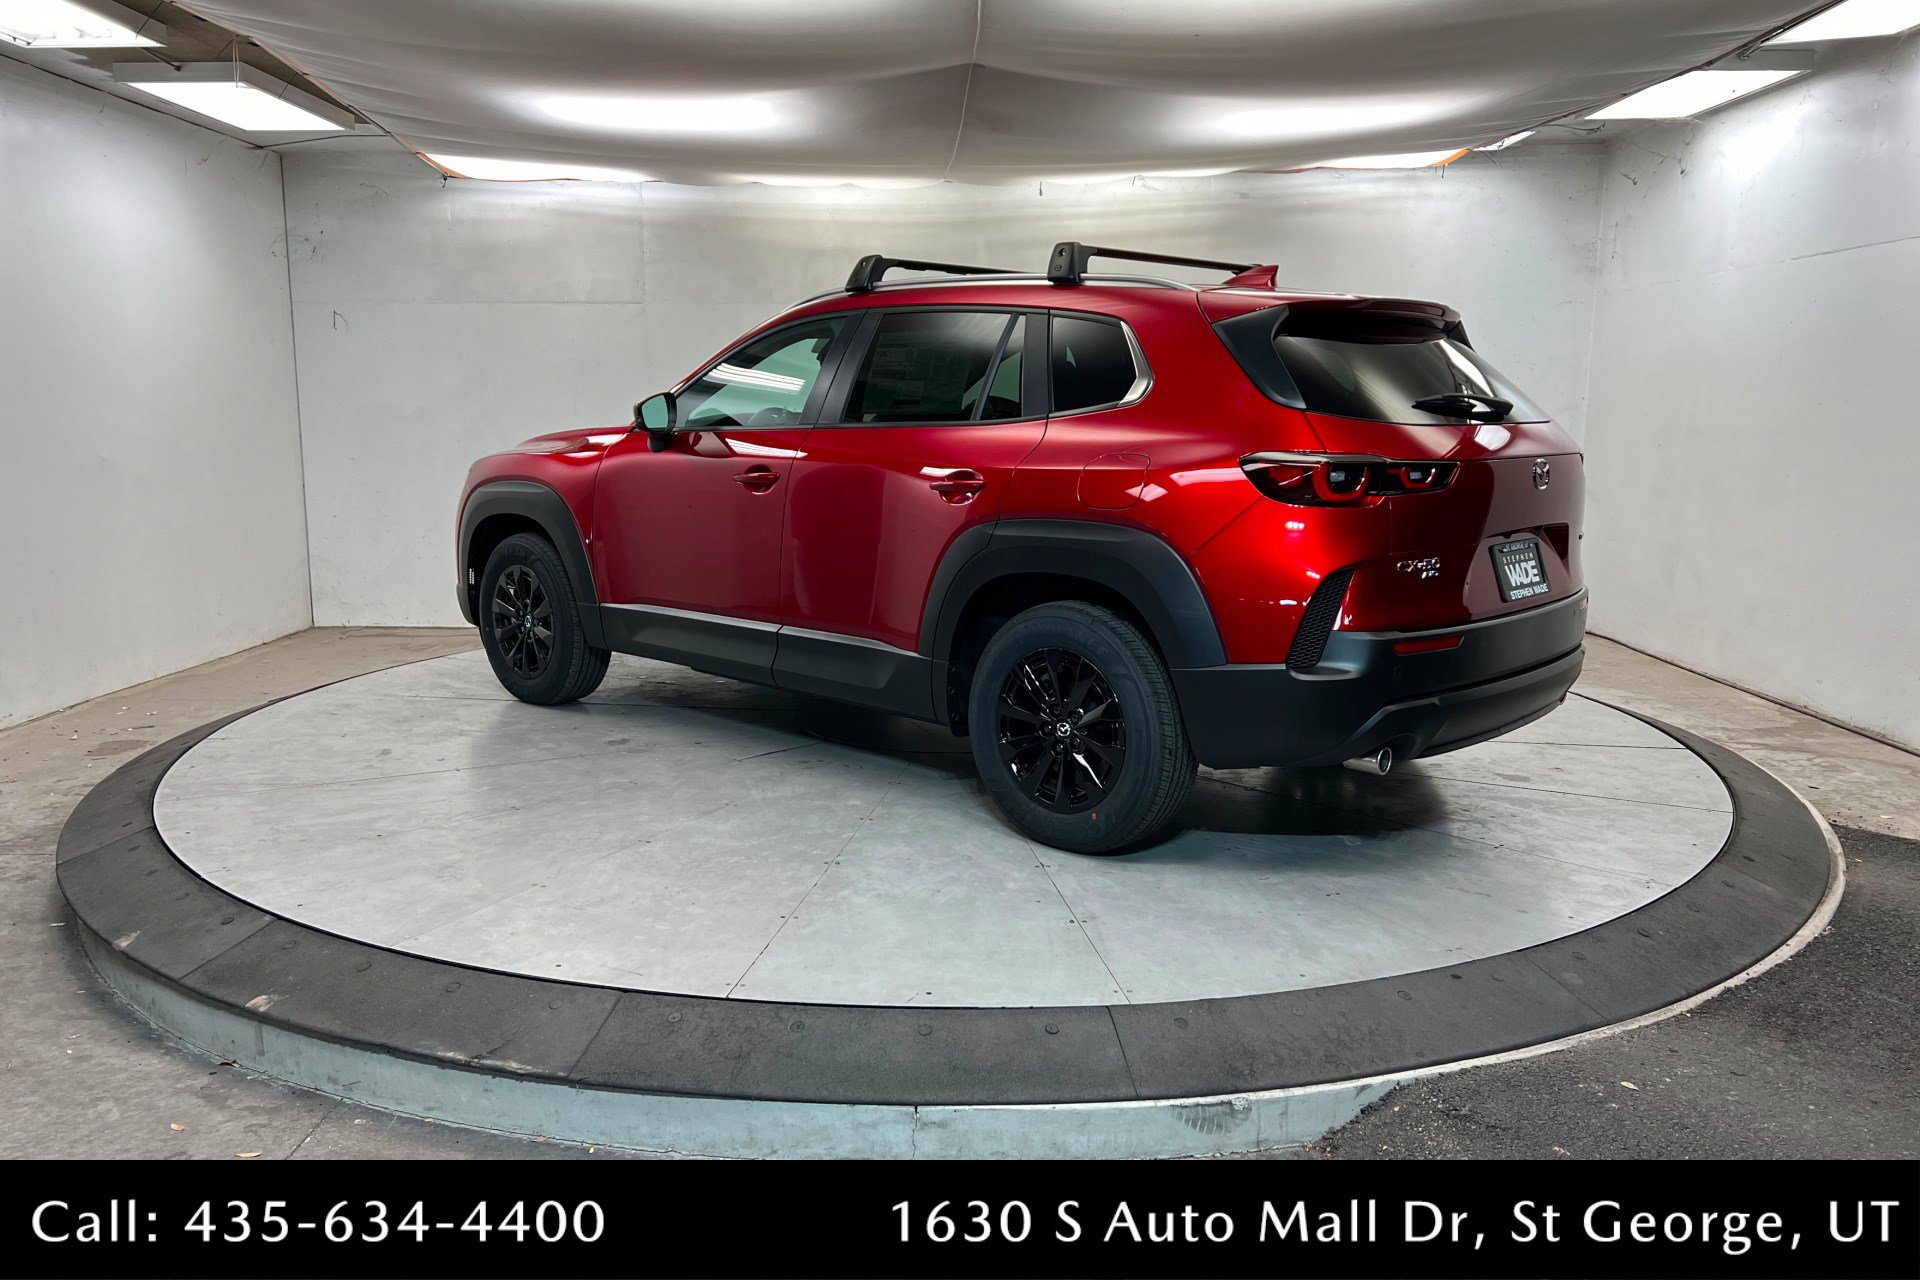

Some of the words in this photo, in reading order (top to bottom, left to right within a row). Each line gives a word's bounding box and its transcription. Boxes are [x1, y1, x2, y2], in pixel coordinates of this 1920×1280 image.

[1396, 557, 1441, 573] CX-50
[1503, 552, 1533, 564] STEPHEN
[1505, 561, 1540, 587] WADE
[1510, 587, 1534, 600] STEPHEN
[1533, 583, 1549, 594] WADE
